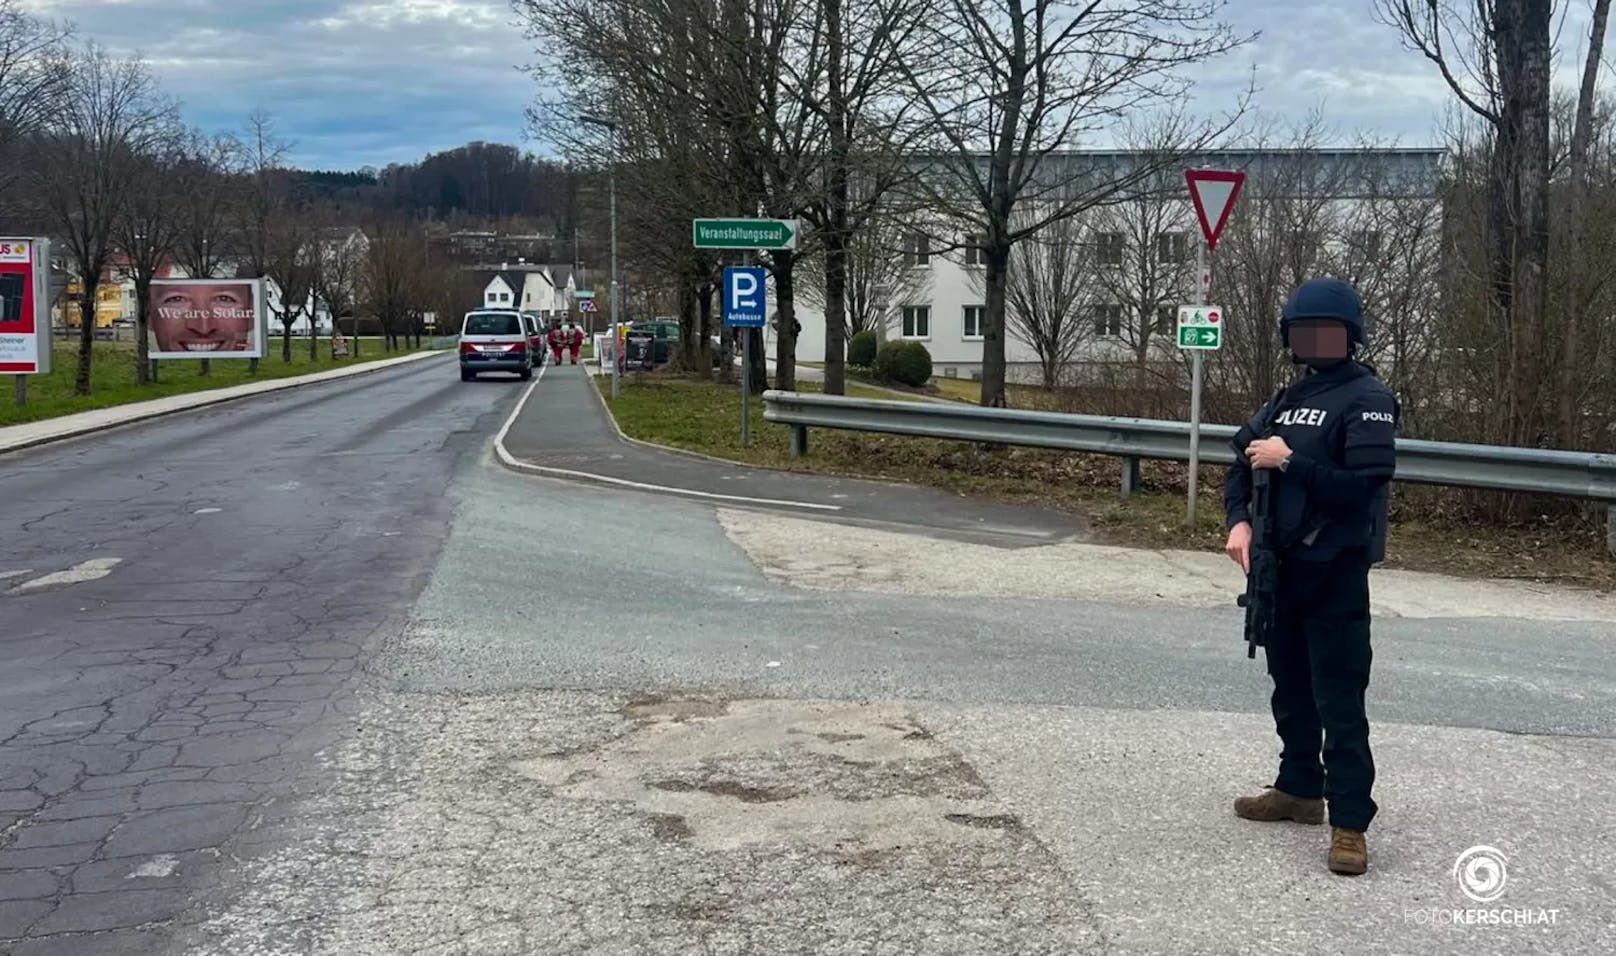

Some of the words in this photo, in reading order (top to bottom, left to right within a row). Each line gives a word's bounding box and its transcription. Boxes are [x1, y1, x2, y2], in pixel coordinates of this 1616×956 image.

[700, 226, 782, 242] Veranstaltungssaal
[732, 272, 758, 309] P
[158, 307, 181, 319] We
[184, 309, 210, 319] are
[728, 313, 762, 321] Autobusse
